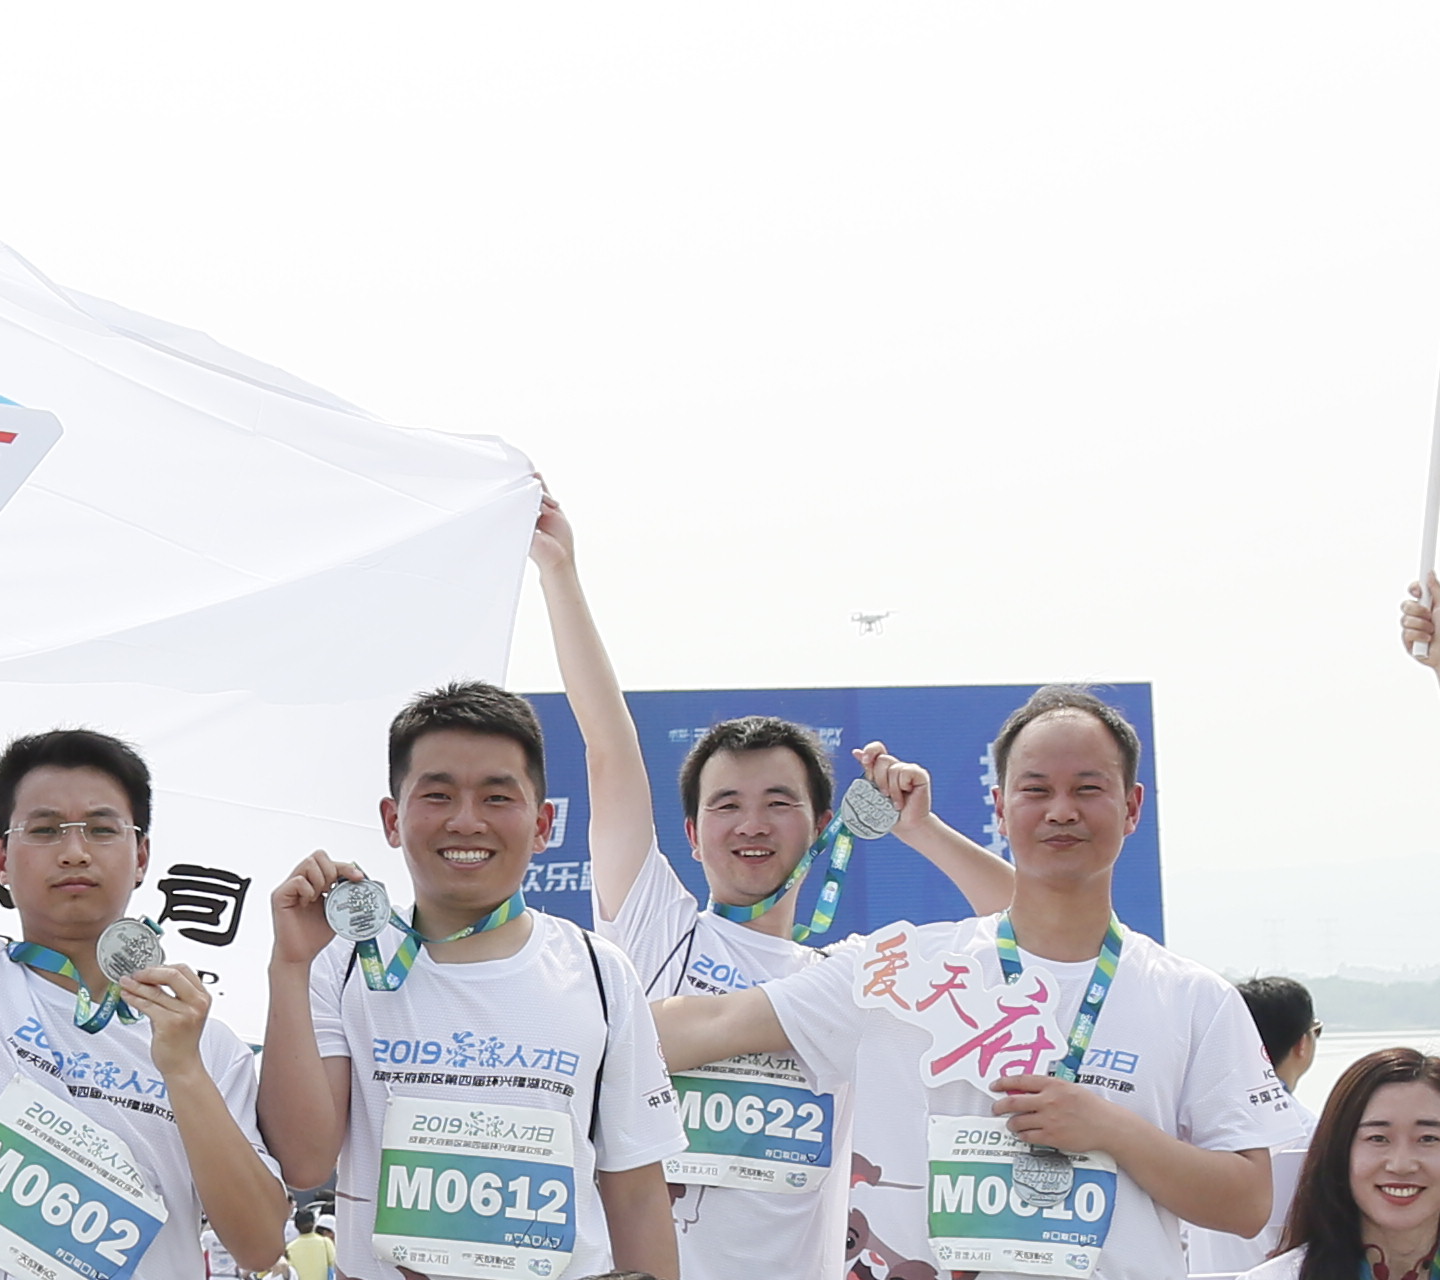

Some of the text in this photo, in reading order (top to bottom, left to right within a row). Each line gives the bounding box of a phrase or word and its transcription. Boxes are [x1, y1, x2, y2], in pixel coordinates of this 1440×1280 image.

[863, 931, 1057, 1095] 爱天府
[678, 1090, 824, 1142] M0622
[386, 1165, 568, 1225] M0612
